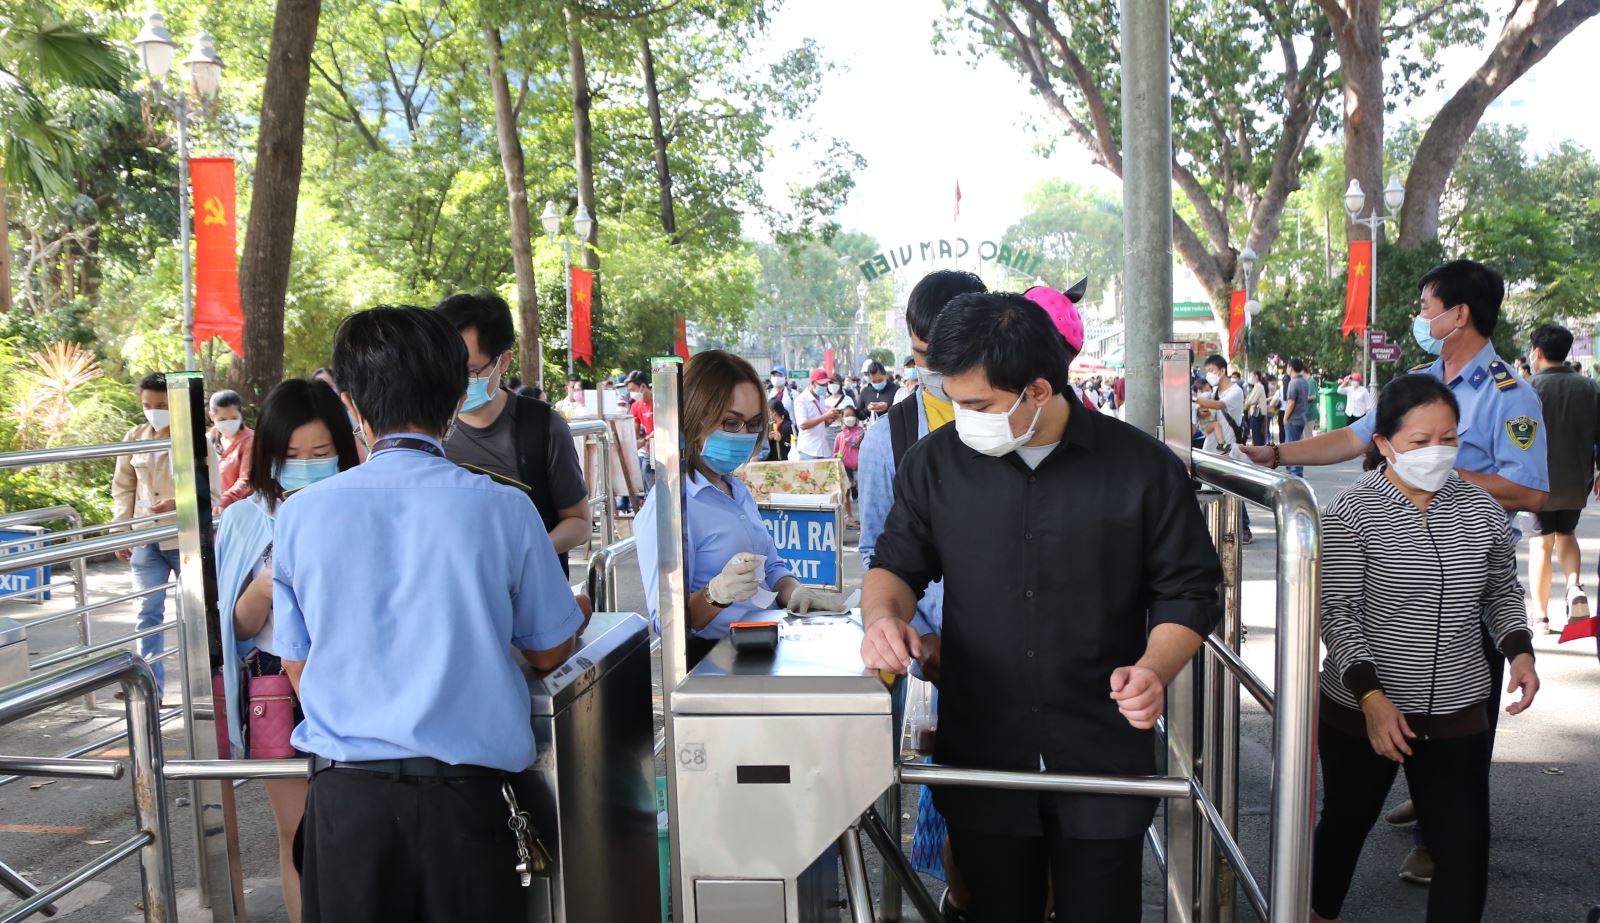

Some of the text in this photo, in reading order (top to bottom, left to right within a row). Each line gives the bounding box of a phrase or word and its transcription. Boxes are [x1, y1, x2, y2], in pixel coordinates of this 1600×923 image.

[808, 521, 836, 551] RA
[784, 559, 820, 578] XIT
[680, 749, 704, 765] C8
